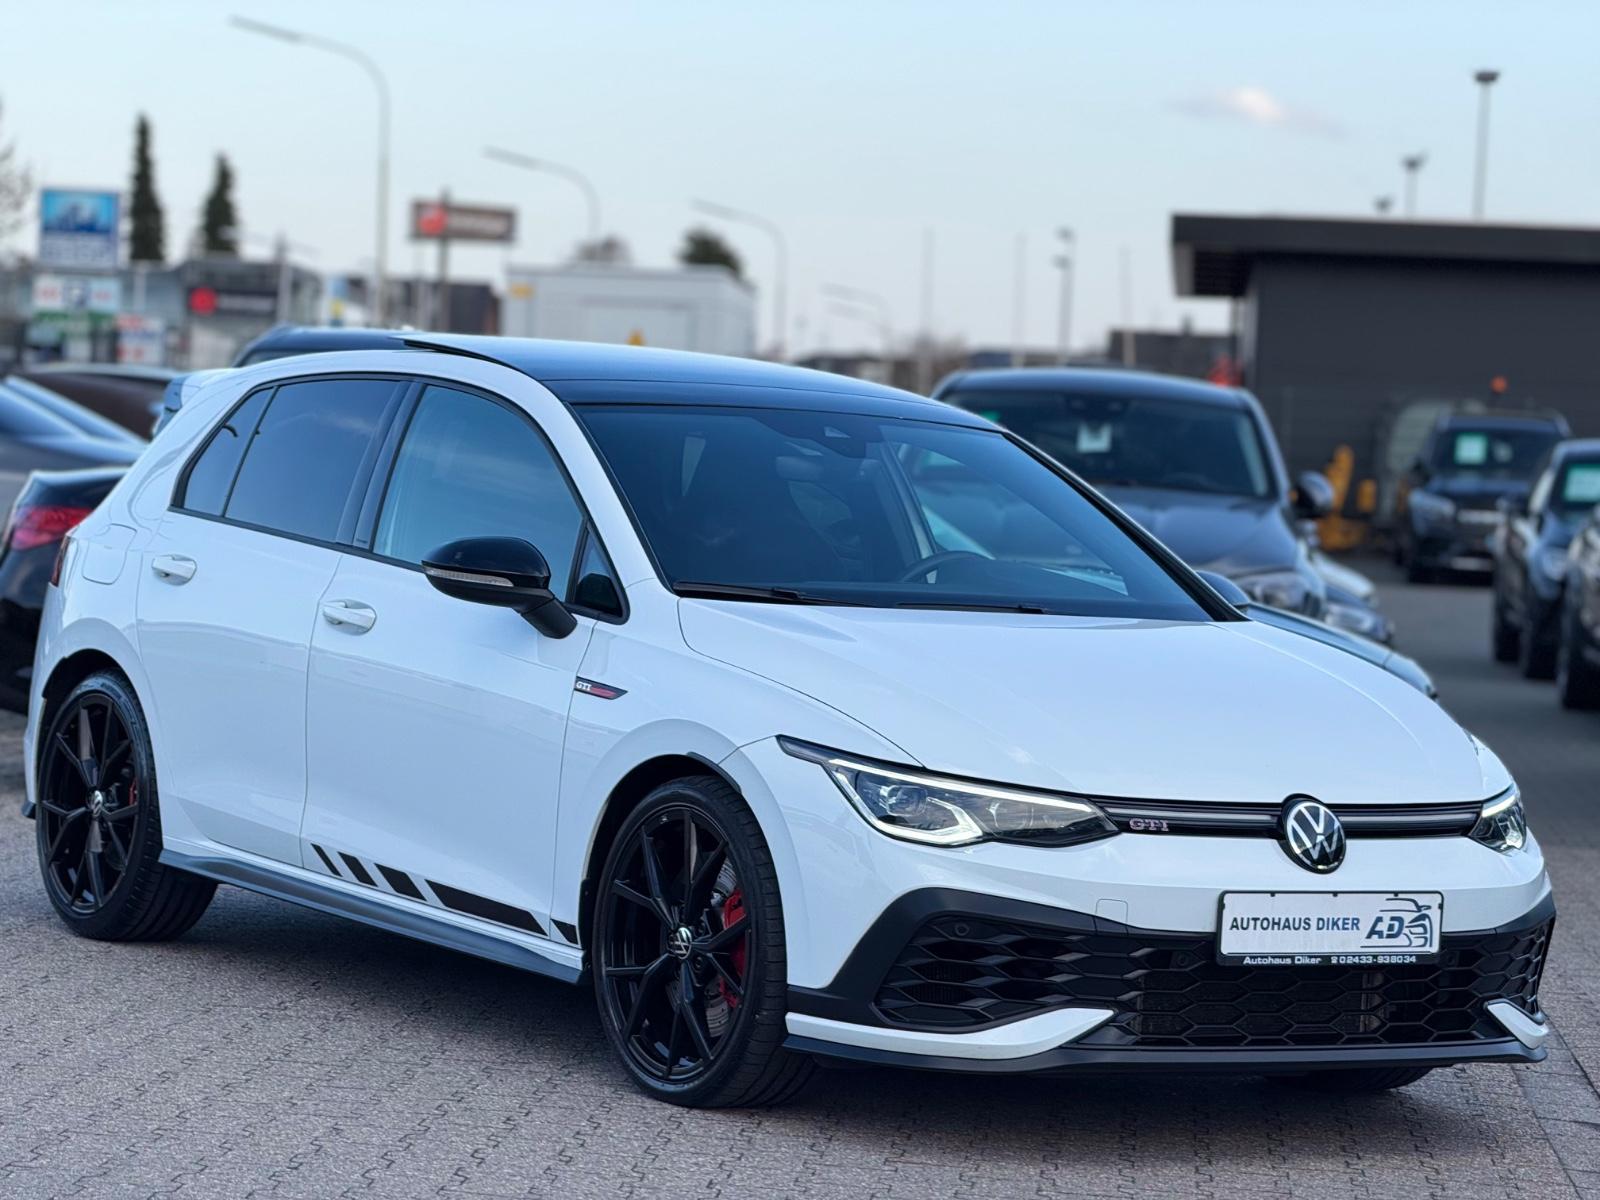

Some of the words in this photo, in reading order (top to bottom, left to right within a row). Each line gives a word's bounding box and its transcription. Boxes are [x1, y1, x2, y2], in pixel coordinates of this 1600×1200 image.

[1128, 817, 1169, 832] GTI
[1229, 917, 1311, 931] AUTOHAUS
[1316, 917, 1360, 931] DIKER
[1365, 916, 1404, 939] AD
[1243, 956, 1292, 965] Autohaus
[1294, 955, 1322, 964] Diker
